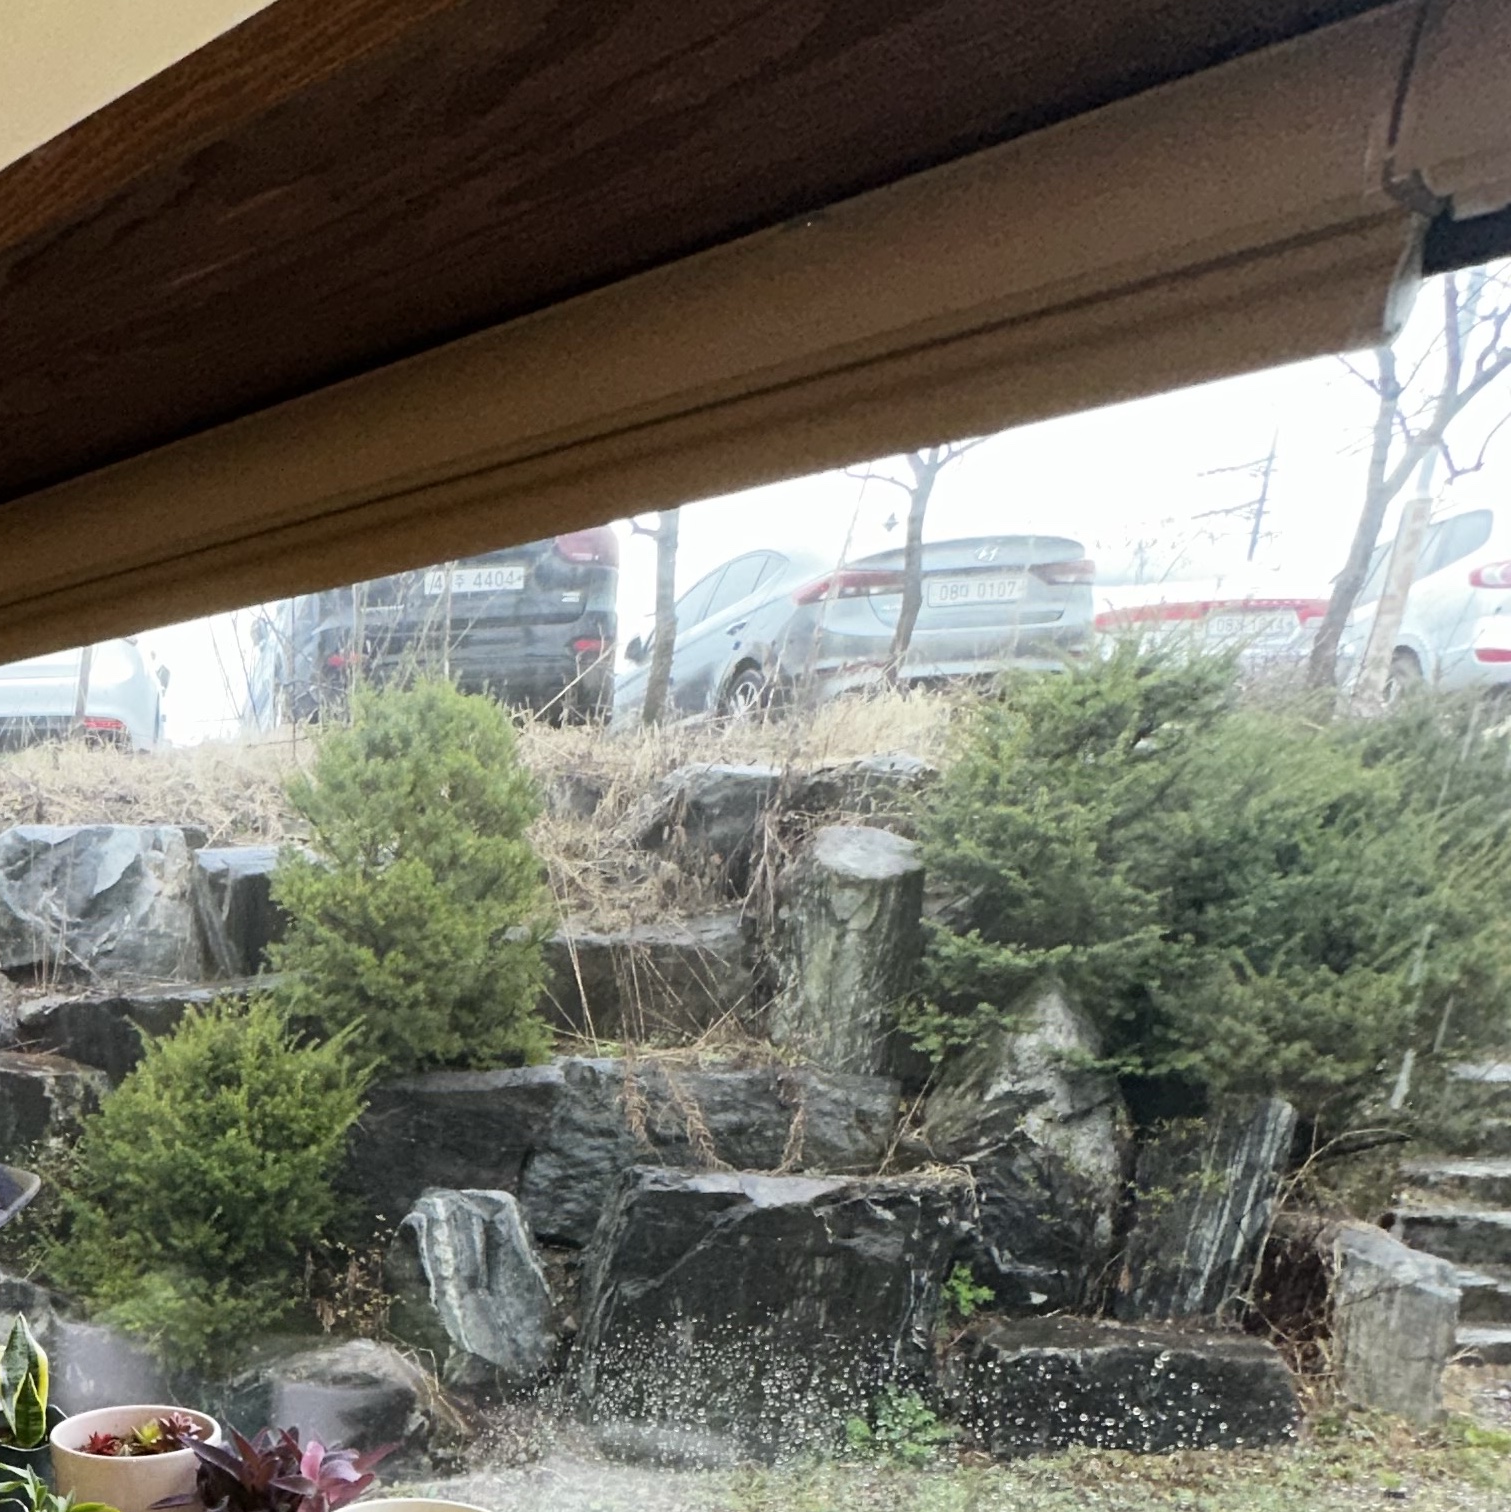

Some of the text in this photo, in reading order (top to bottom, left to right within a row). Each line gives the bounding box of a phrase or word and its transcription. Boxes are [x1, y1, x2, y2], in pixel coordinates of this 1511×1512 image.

[433, 571, 515, 590] 4주 4404
[977, 581, 1017, 599] 0107
